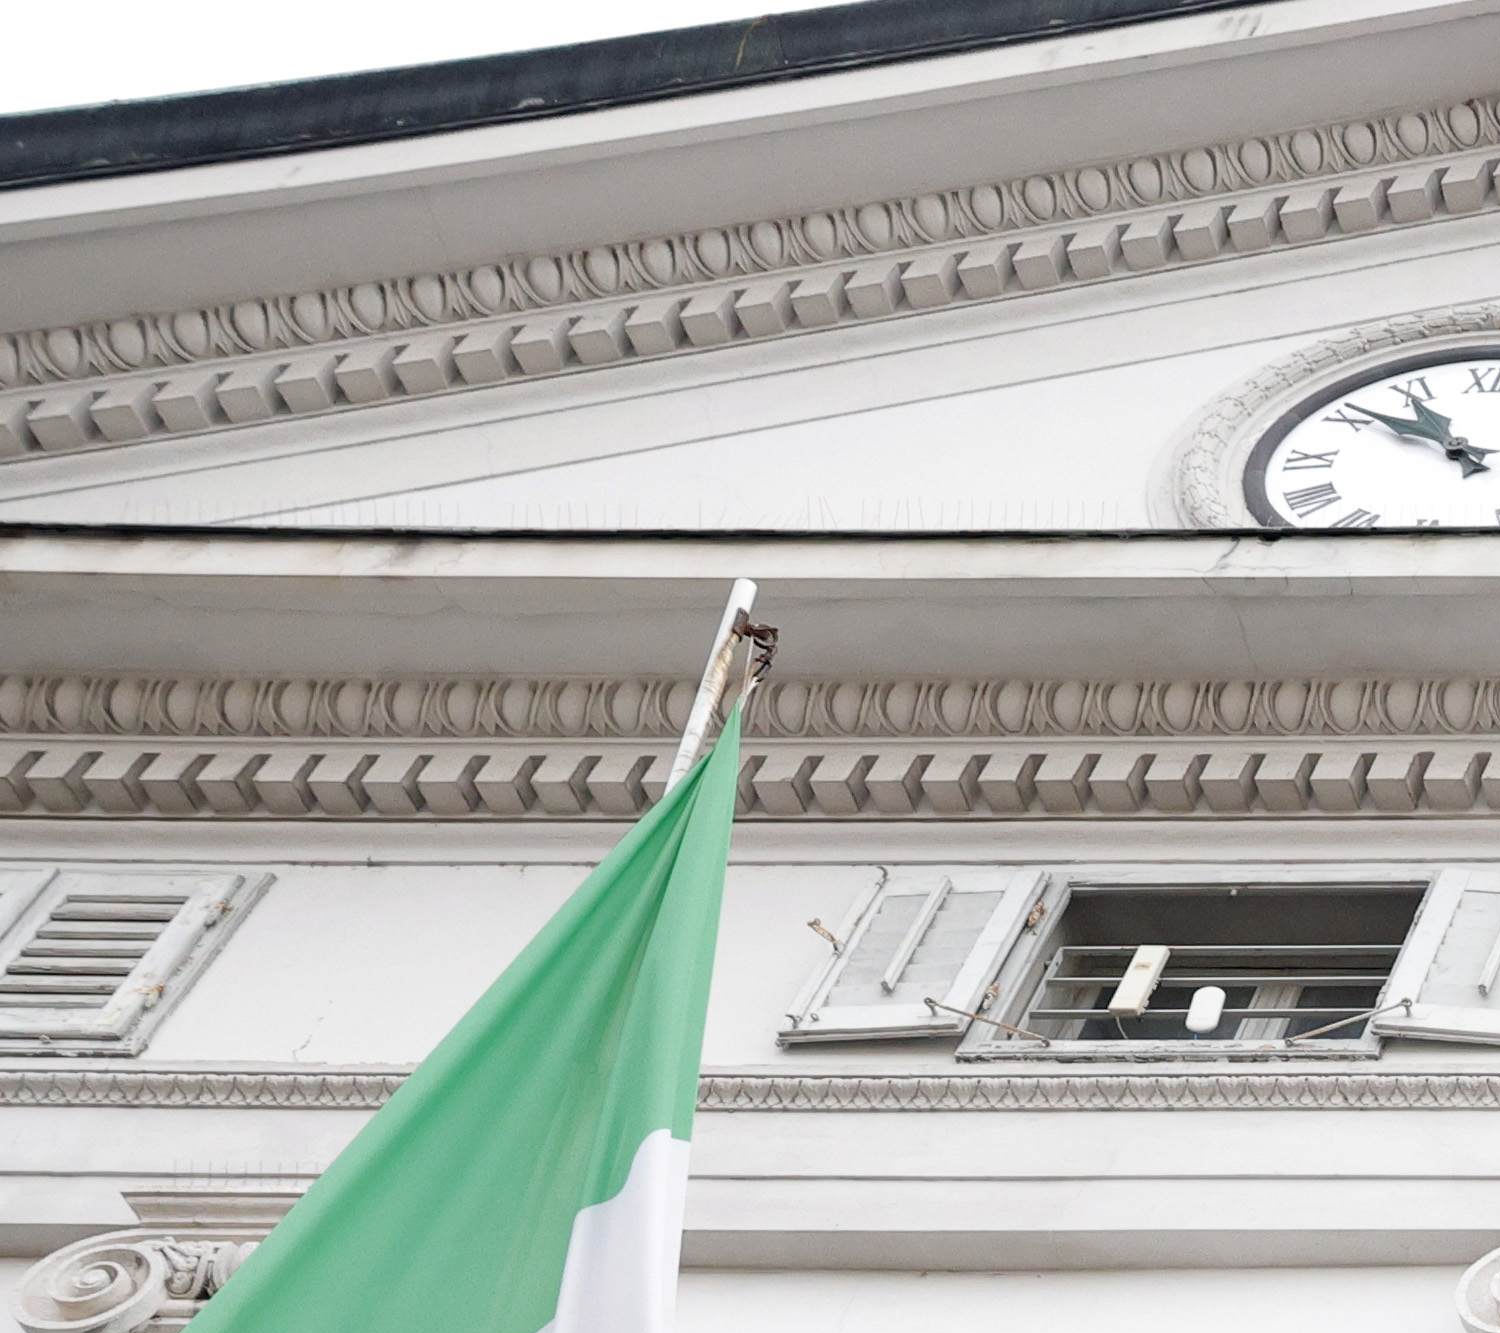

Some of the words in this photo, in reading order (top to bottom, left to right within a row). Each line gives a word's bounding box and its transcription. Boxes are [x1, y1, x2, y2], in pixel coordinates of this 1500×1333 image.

[1388, 376, 1437, 409] XI
[1321, 408, 1375, 433] X
[1282, 449, 1341, 471] IX
[1282, 481, 1343, 519] VIII
